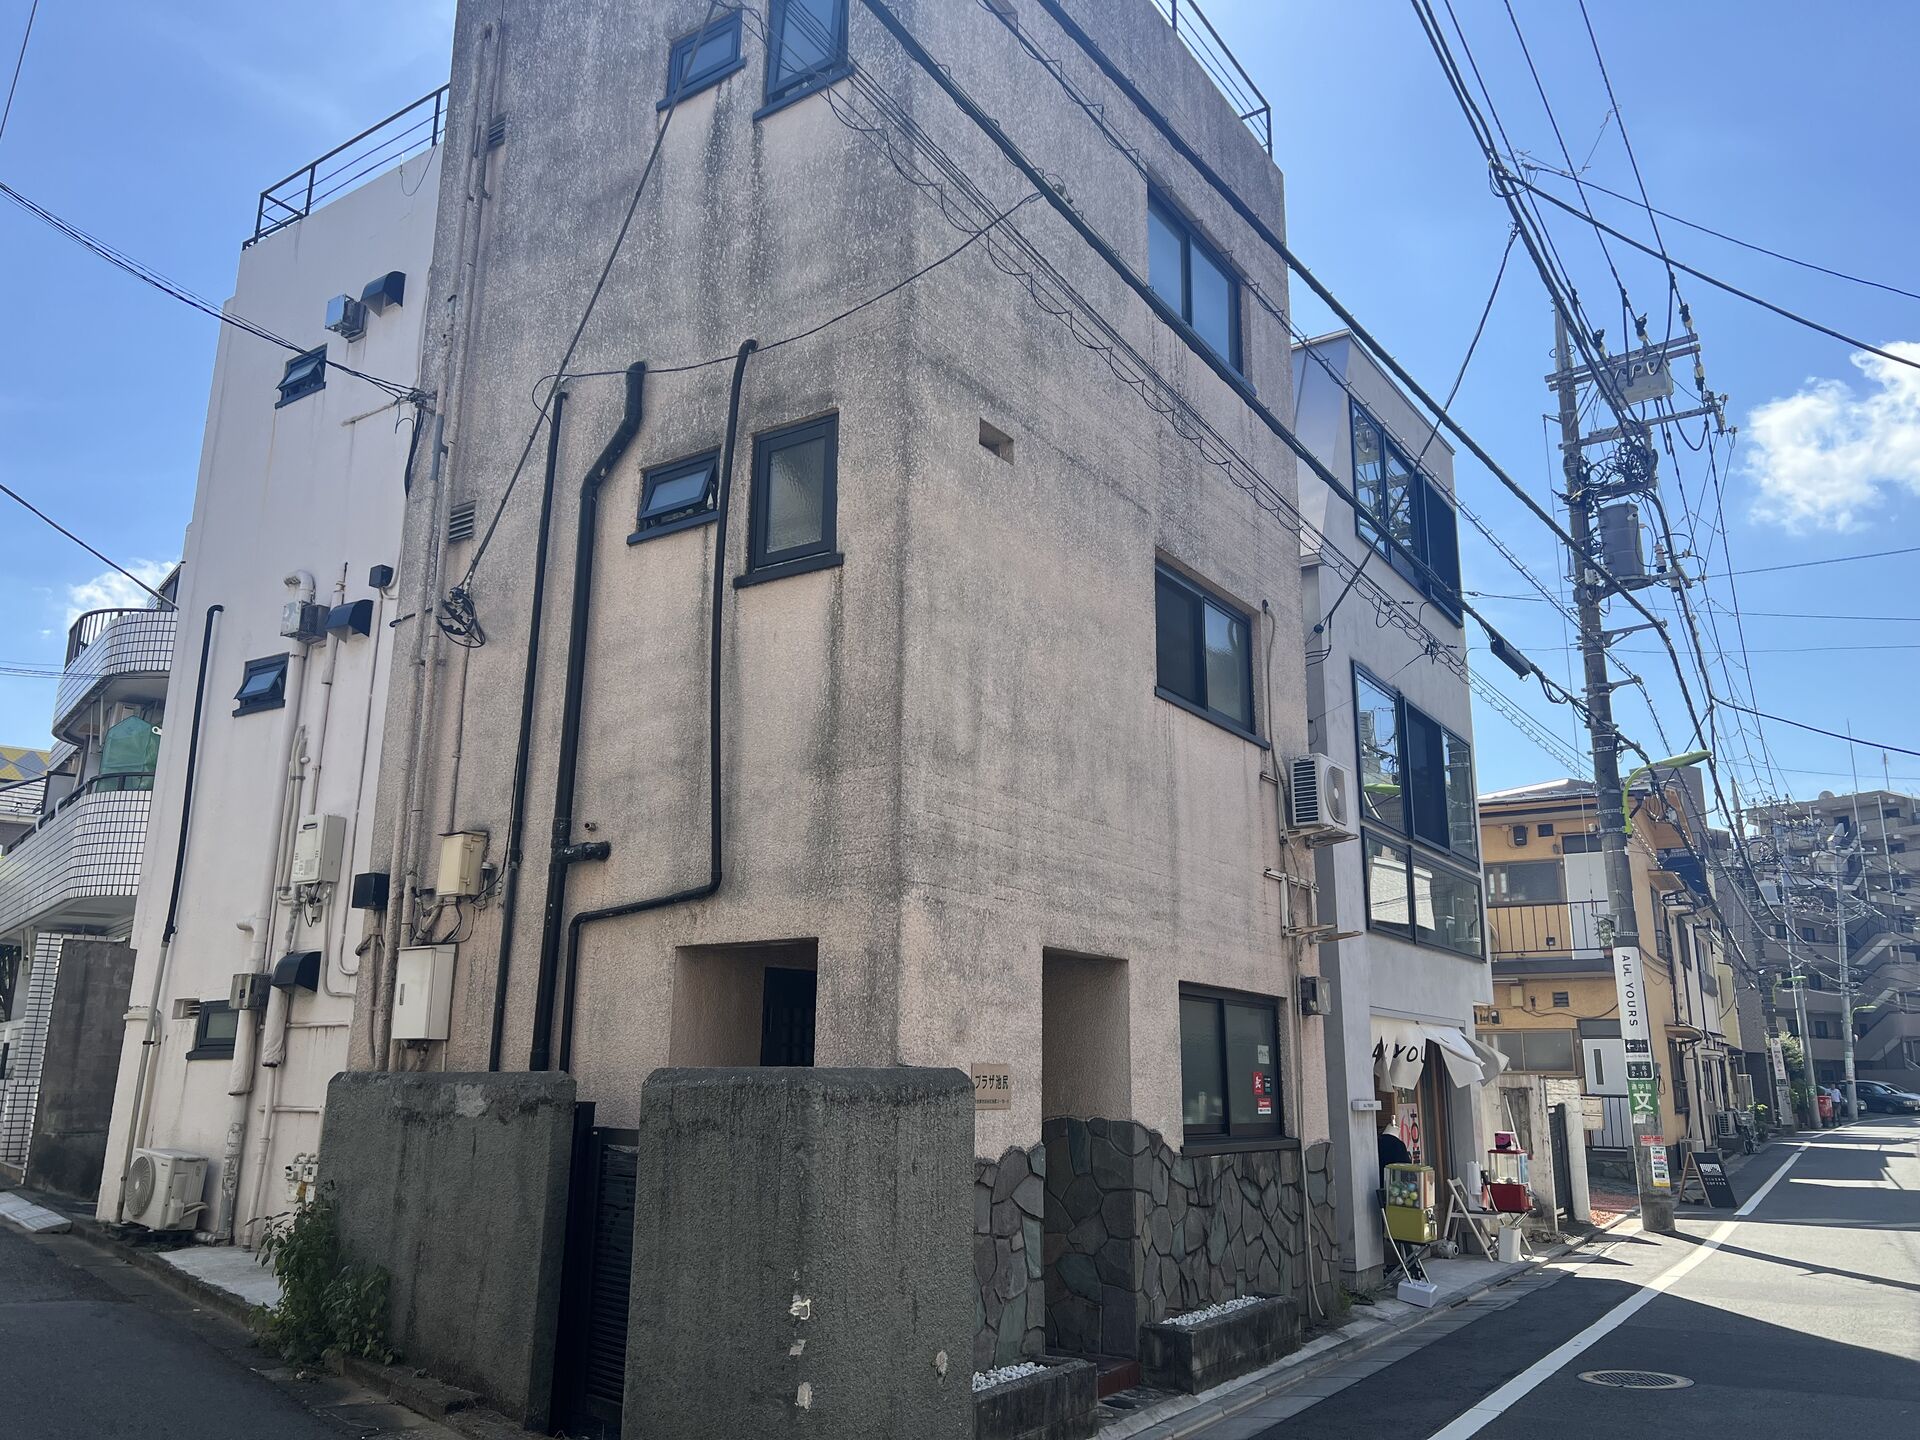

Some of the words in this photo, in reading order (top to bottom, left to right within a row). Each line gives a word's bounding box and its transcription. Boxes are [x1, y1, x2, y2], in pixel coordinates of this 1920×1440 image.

[1621, 954, 1633, 977] ALL
[1625, 982, 1638, 1027] YOURS
[975, 1074, 1009, 1090] プラザ池尻
[1633, 1090, 1654, 1111] 文
